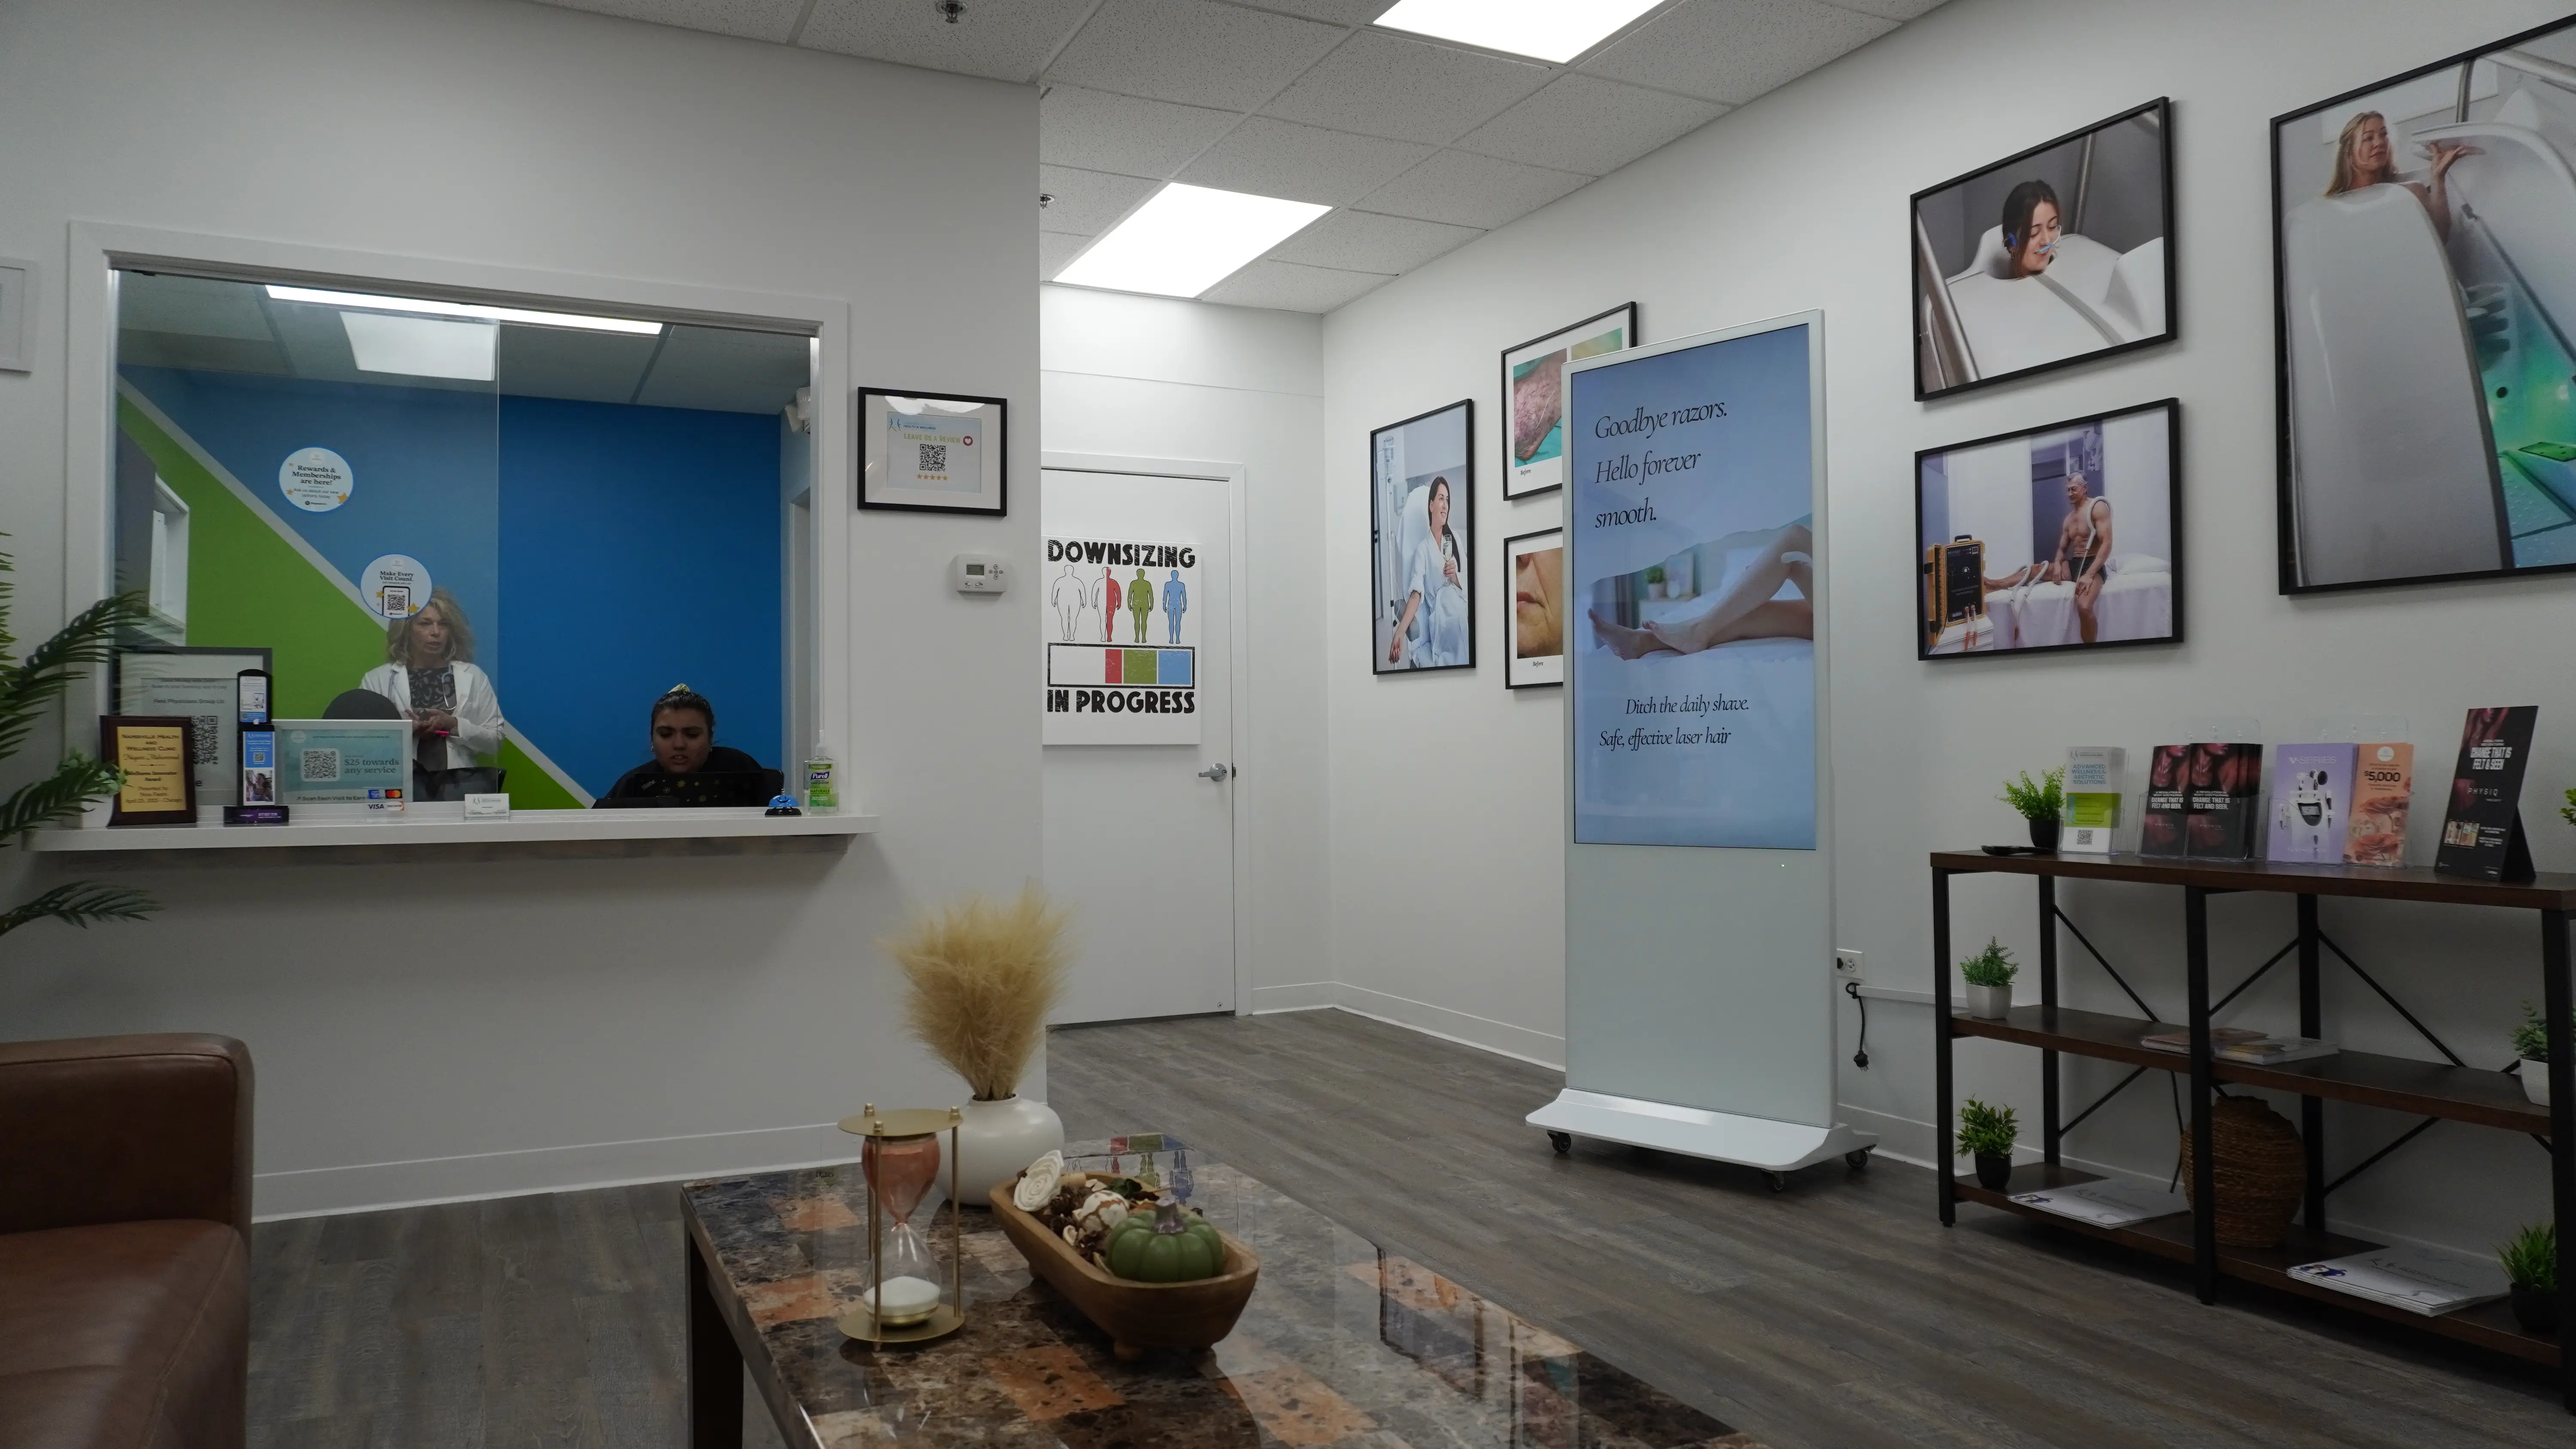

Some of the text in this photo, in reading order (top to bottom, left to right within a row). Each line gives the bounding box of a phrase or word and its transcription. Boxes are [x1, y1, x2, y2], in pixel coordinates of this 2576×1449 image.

[1595, 401, 1728, 439] Goodbye razors.
[292, 471, 341, 480] Memberships
[1595, 451, 1701, 485] Hello forever
[1595, 497, 1657, 528] smooth.
[1048, 540, 1195, 568] DOWNSIZING
[1047, 690, 1195, 713] IN PROGRESS
[1625, 694, 1749, 717] Ditch the daily shave.
[1600, 727, 1732, 751] Safe, effective laser hair
[2364, 771, 2401, 782] $5,000
[2468, 788, 2498, 797] PHYSIQ
